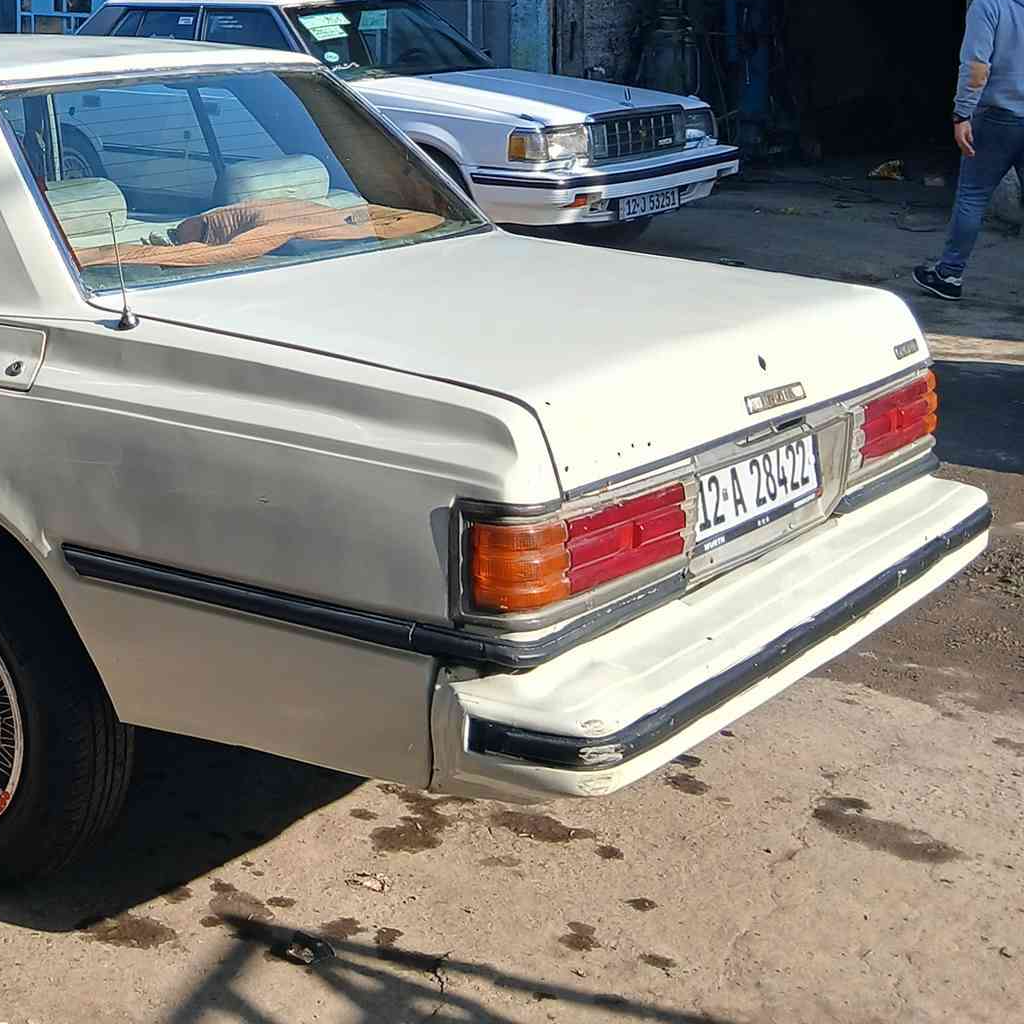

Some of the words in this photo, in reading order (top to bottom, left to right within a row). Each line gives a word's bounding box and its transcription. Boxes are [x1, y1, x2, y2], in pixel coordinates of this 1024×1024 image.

[626, 198, 638, 216] 12
[649, 190, 676, 211] 53251
[699, 475, 726, 532] 12
[730, 467, 747, 516] A
[749, 440, 810, 507] 28422
